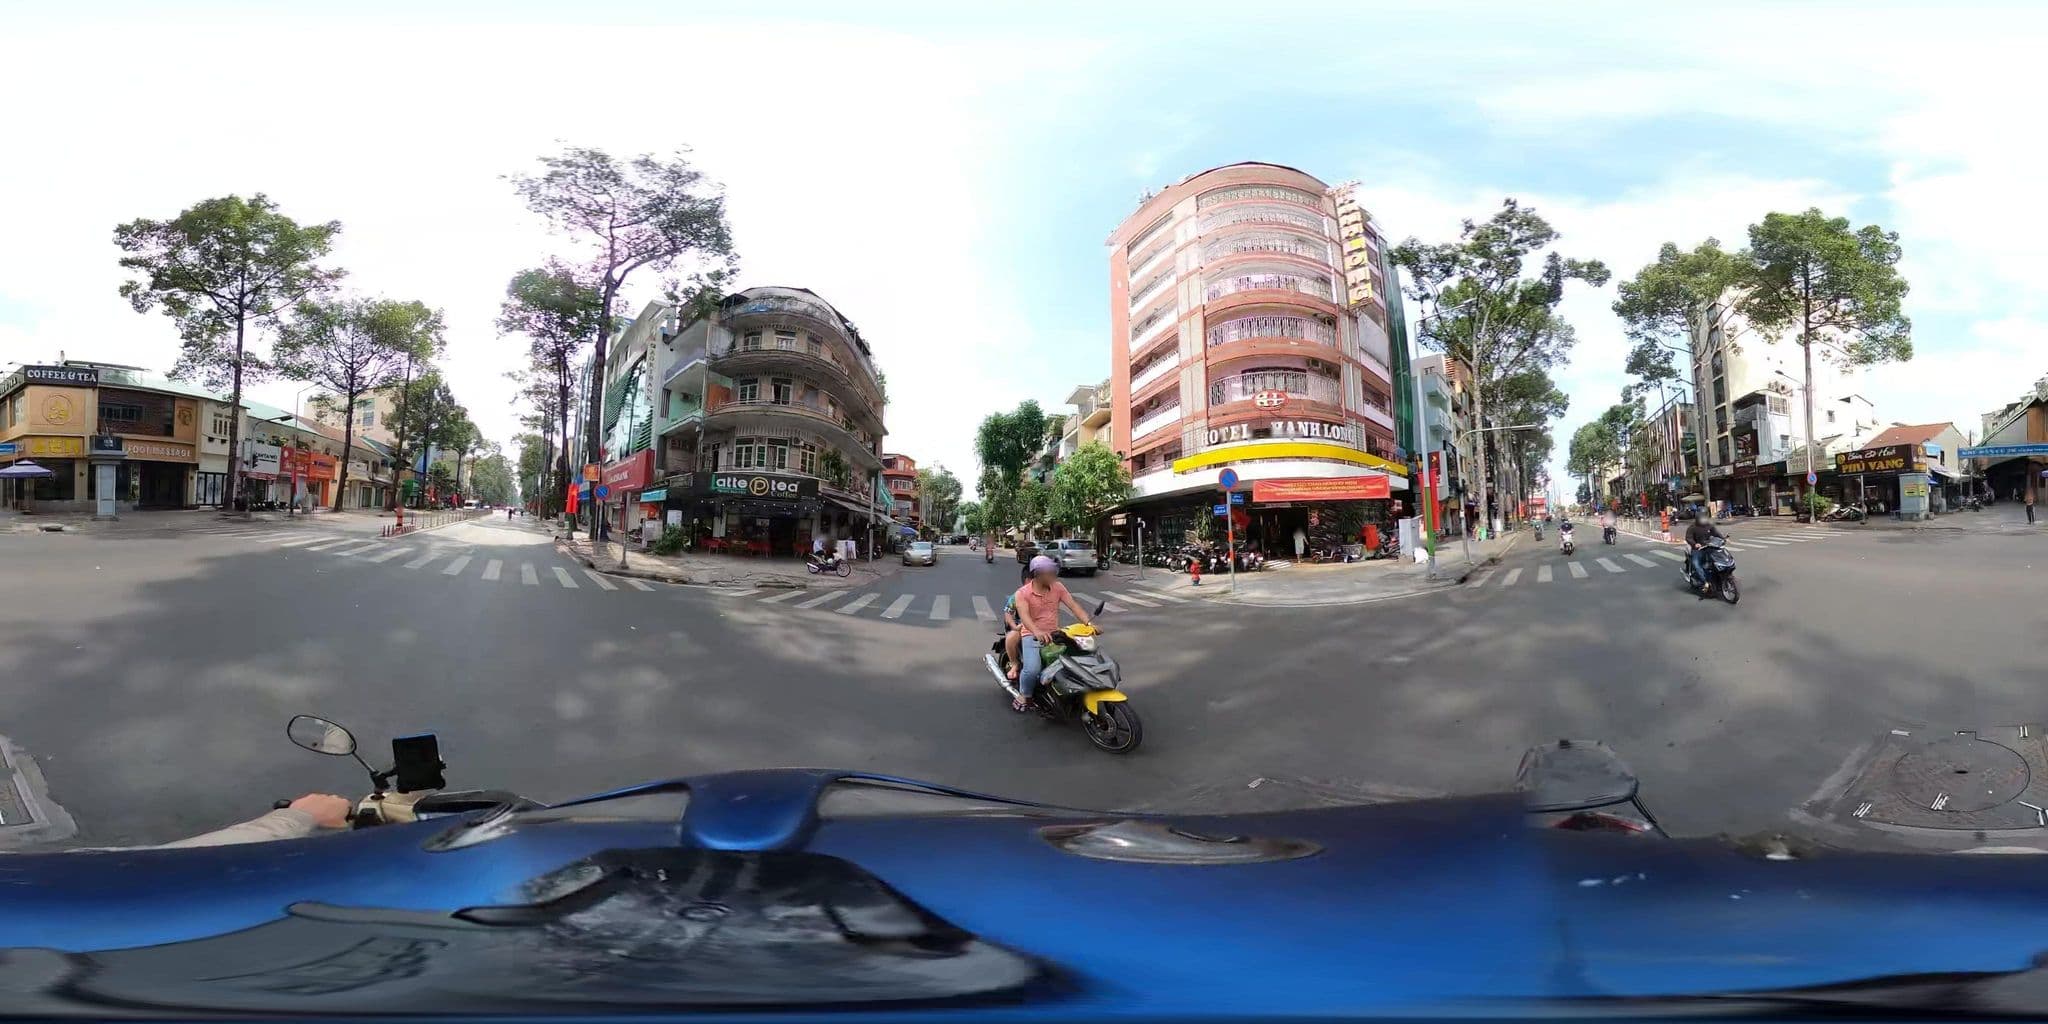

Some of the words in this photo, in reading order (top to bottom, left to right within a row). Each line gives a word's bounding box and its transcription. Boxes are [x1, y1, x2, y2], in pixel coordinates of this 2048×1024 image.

[27, 369, 66, 380] COFFEE
[68, 371, 75, 380] &
[77, 373, 96, 382] TEA
[711, 474, 748, 490] Latte
[771, 479, 798, 492] tea
